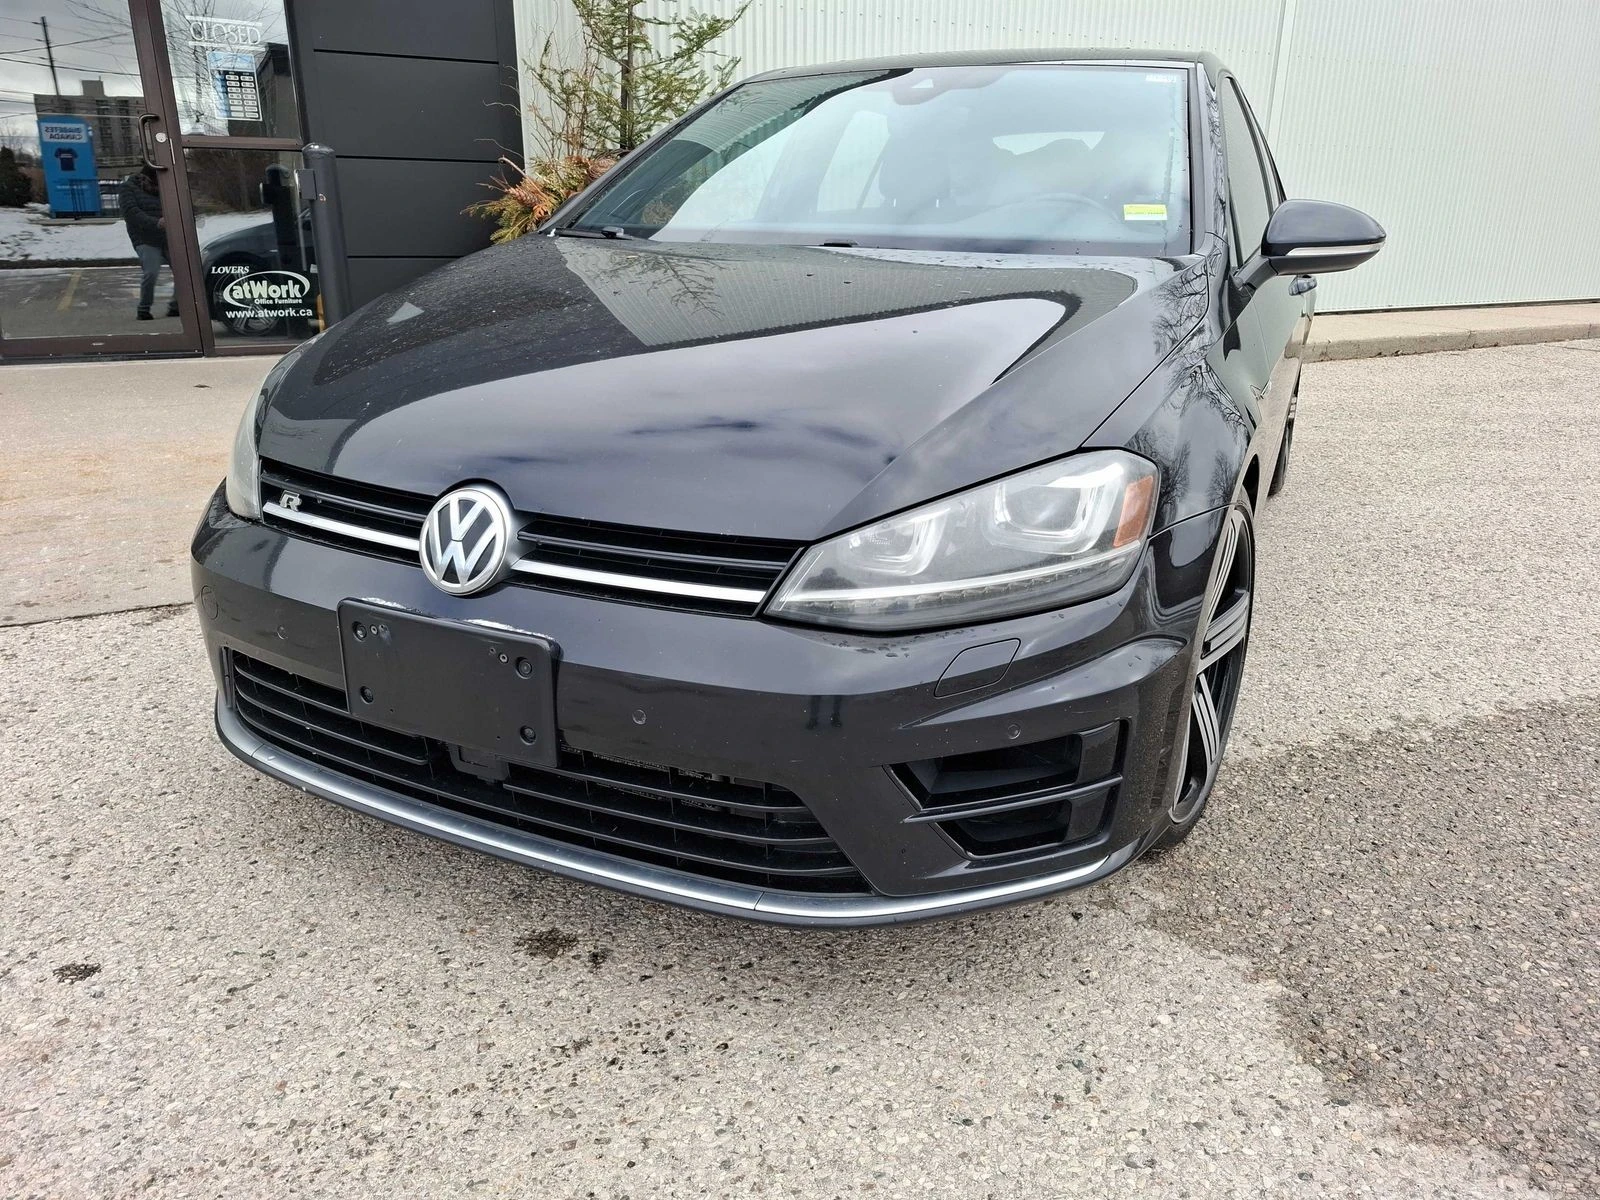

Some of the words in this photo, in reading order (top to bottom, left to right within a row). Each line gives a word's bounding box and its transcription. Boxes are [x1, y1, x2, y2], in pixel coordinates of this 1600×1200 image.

[190, 21, 261, 45] CLOSED
[211, 265, 249, 274] LOVERS
[232, 280, 302, 299] atWork
[225, 307, 313, 318] www.atwork.ca
[279, 490, 302, 512] R
